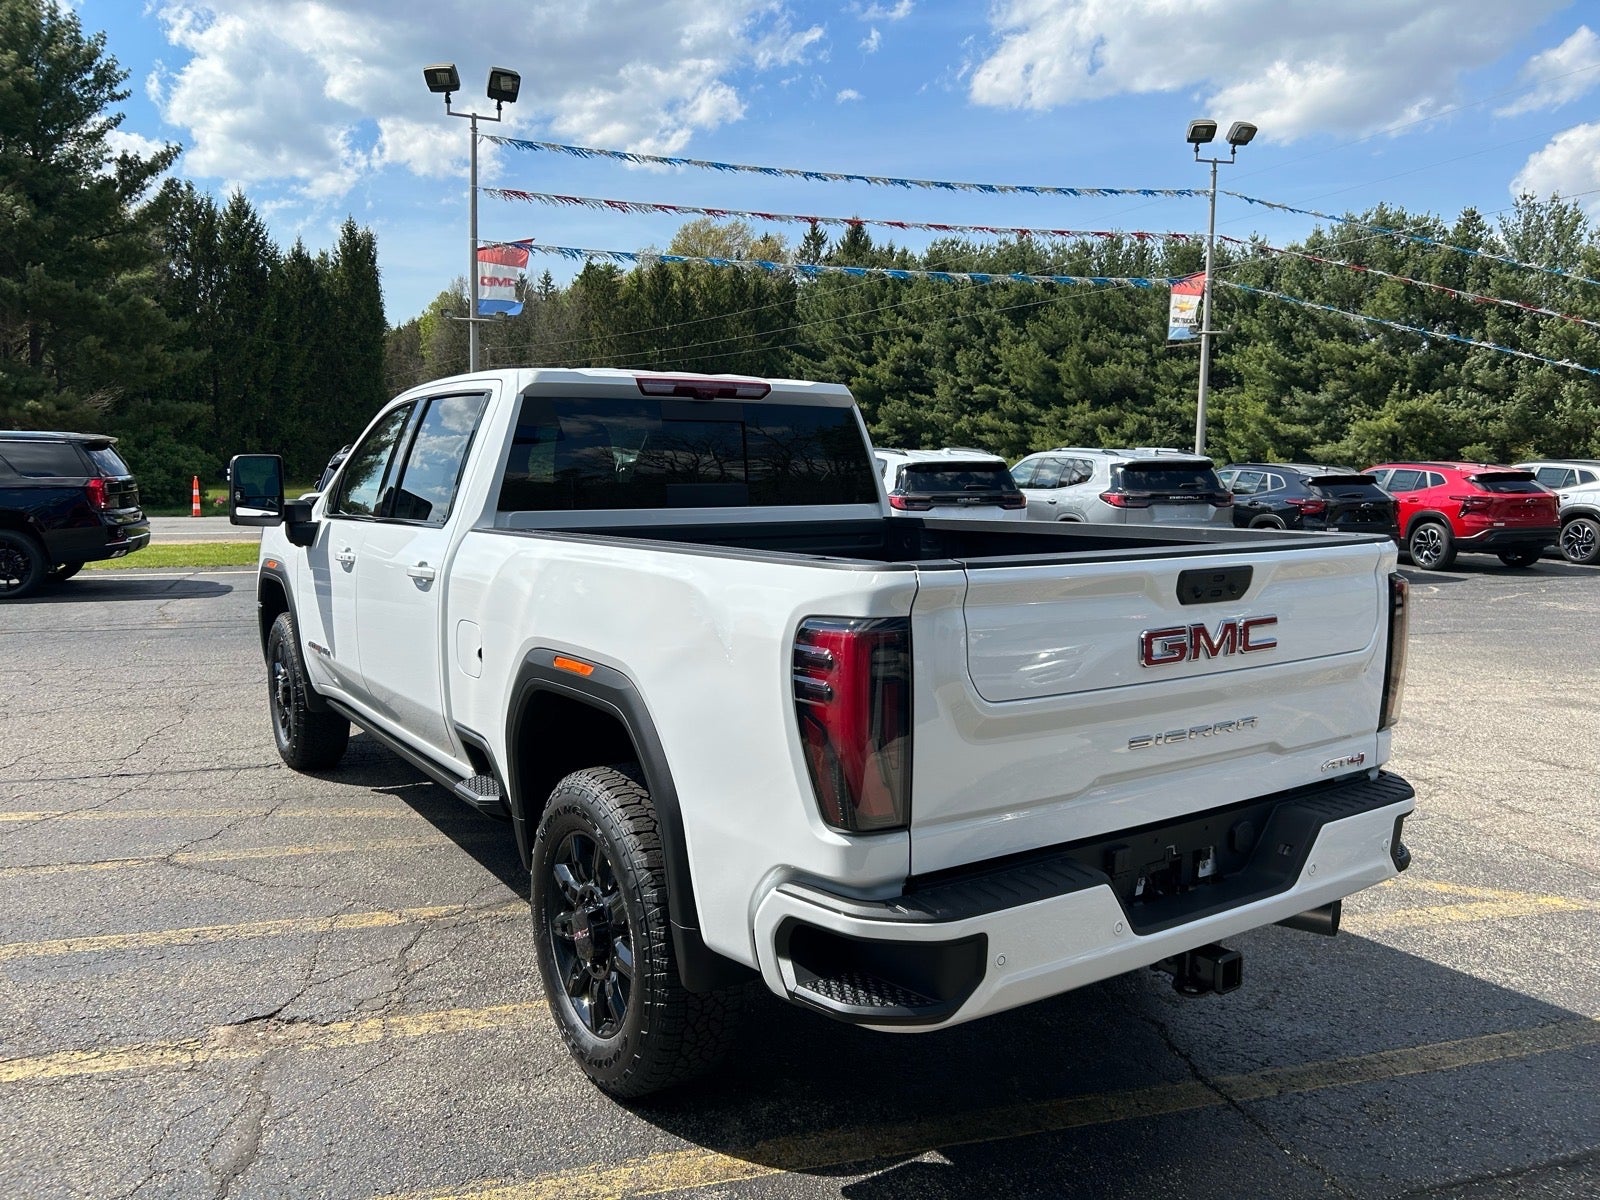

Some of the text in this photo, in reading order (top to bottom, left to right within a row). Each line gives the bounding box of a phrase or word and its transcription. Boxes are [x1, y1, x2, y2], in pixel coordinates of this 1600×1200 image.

[480, 276, 516, 287] GMC
[1138, 613, 1278, 667] GMC
[1128, 715, 1258, 750] SIERRA
